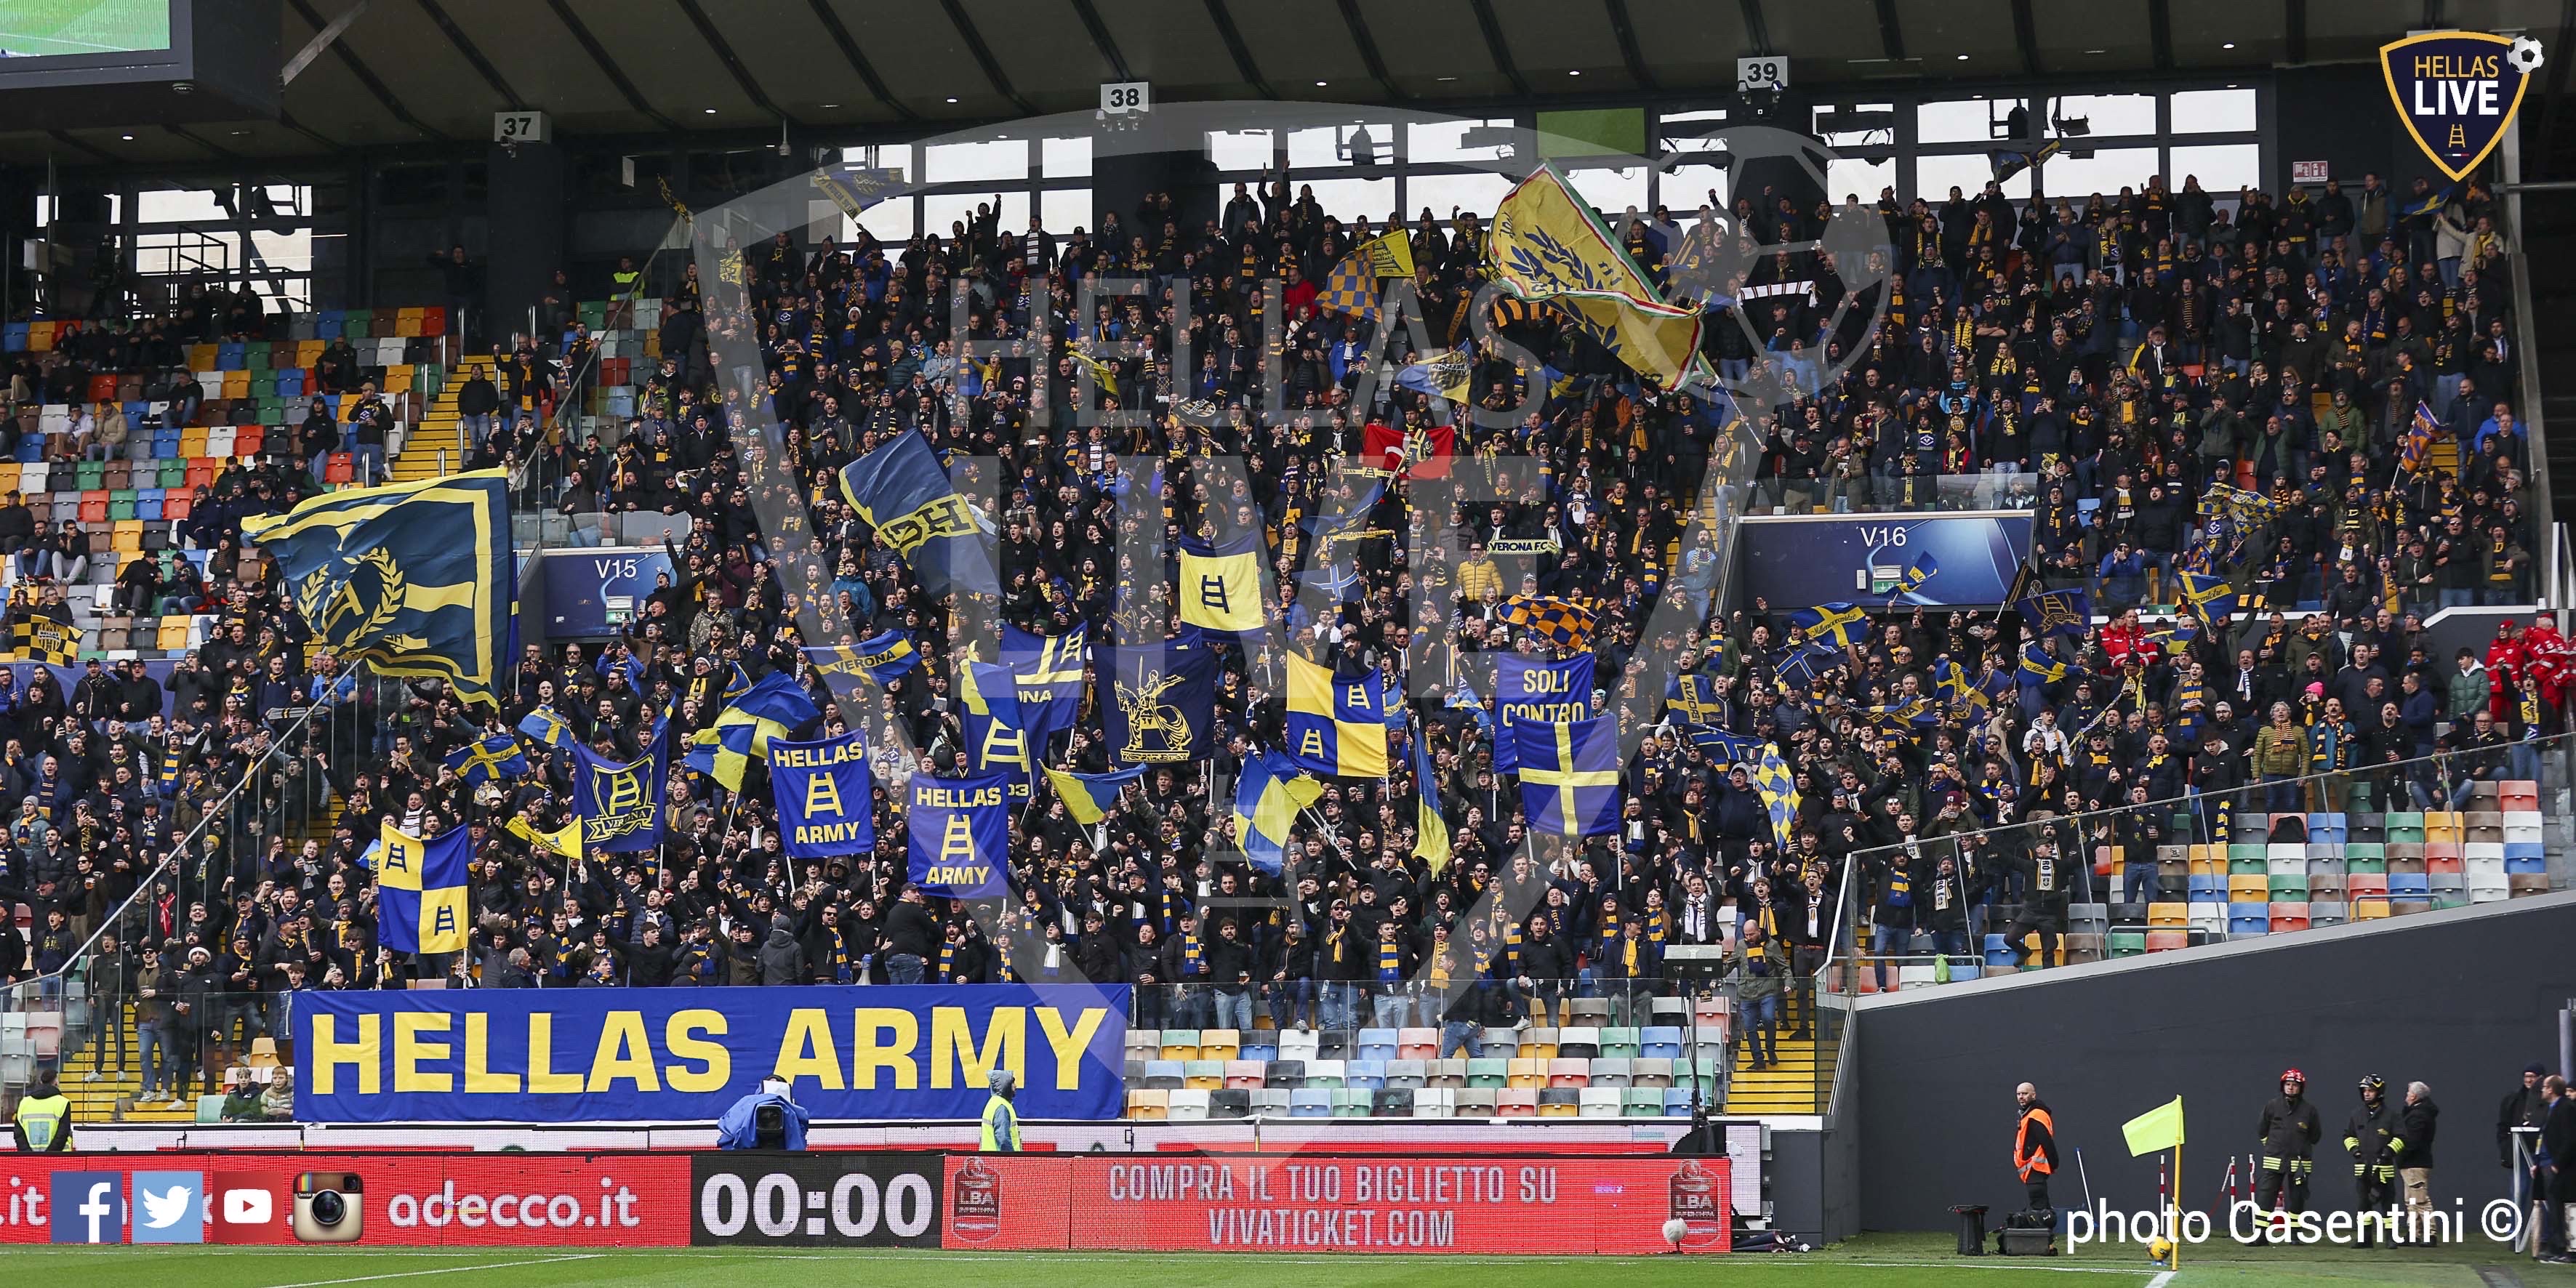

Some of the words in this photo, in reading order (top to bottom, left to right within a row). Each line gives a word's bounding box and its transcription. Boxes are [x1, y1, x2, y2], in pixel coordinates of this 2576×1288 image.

[1746, 63, 1778, 82] 39
[1110, 88, 1139, 107] 38
[503, 117, 531, 136] 37
[1490, 542, 1533, 552] VERONA
[1861, 527, 1907, 547] V16
[595, 559, 637, 579] V15
[835, 649, 896, 673] VERONA
[1523, 669, 1570, 693] SOLI
[1502, 701, 1585, 728] CONTRO
[774, 741, 863, 768] HELLAS
[916, 786, 1002, 808] HELLAS
[606, 810, 647, 830] VERONA
[795, 821, 859, 845] ARMY
[926, 866, 990, 885] ARMY
[311, 1008, 731, 1095] HELLAS
[774, 1006, 1108, 1090] ARMY
[1110, 1164, 1234, 1201] COMPRA
[1248, 1166, 1273, 1202] IL
[1287, 1166, 1341, 1202] TUO
[1357, 1166, 1504, 1203] BIGLIETTO
[1519, 1167, 1557, 1203] SU
[388, 1177, 640, 1228] adecco.it
[700, 1172, 933, 1238] 00:00
[959, 1191, 995, 1204] LBA
[1675, 1194, 1713, 1208] LBA
[1209, 1209, 1454, 1246] VIVATICKET.COM
